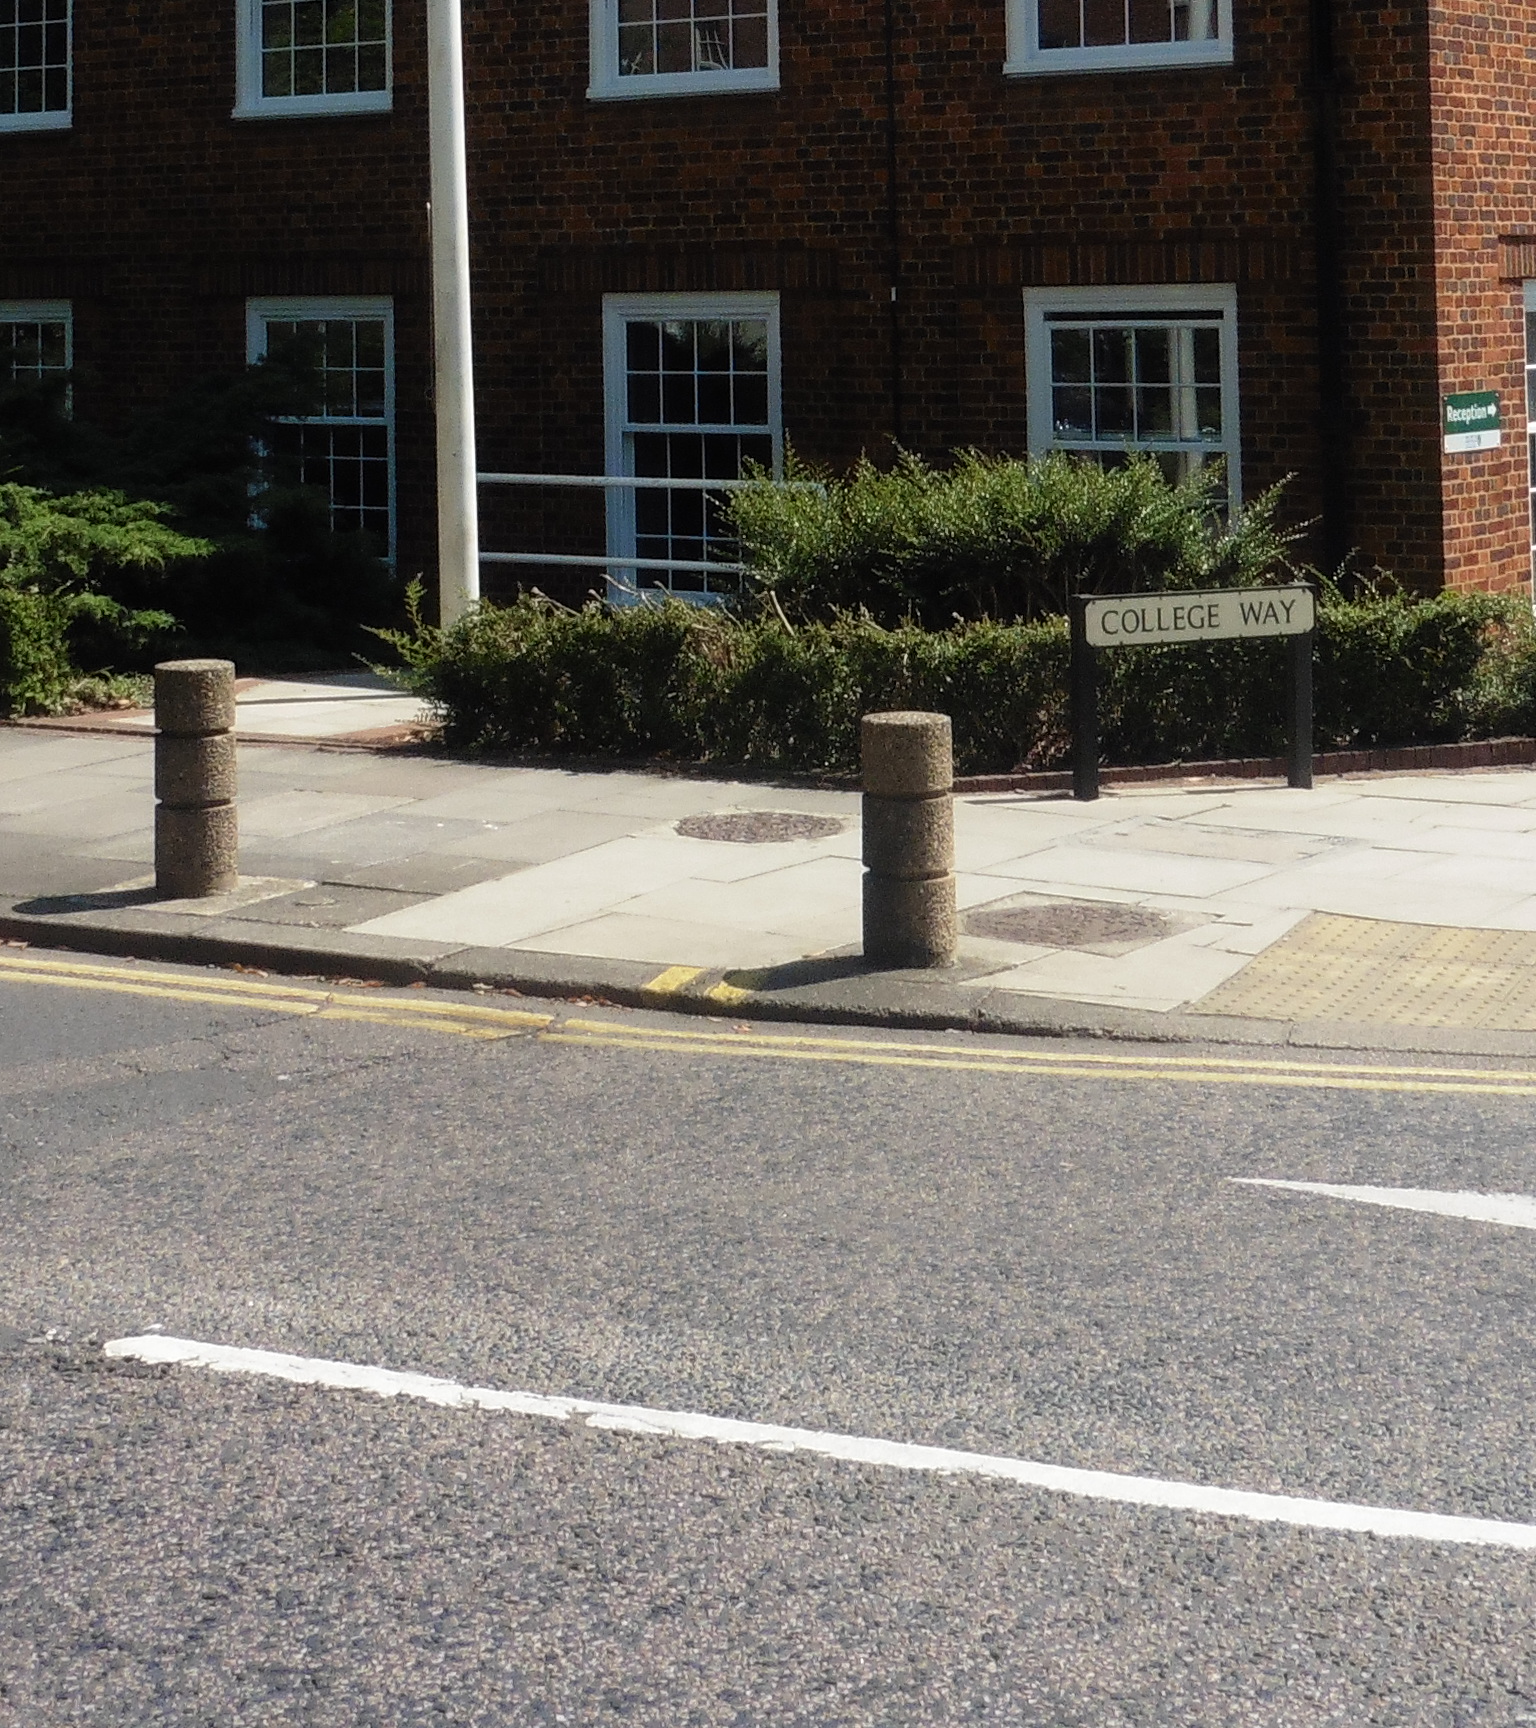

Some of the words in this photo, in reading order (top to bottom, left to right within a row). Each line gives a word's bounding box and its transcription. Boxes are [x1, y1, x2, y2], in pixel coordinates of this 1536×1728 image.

[1446, 403, 1488, 425] Reception
[1101, 603, 1220, 635] COLLEGE
[1239, 599, 1296, 626] WAY
